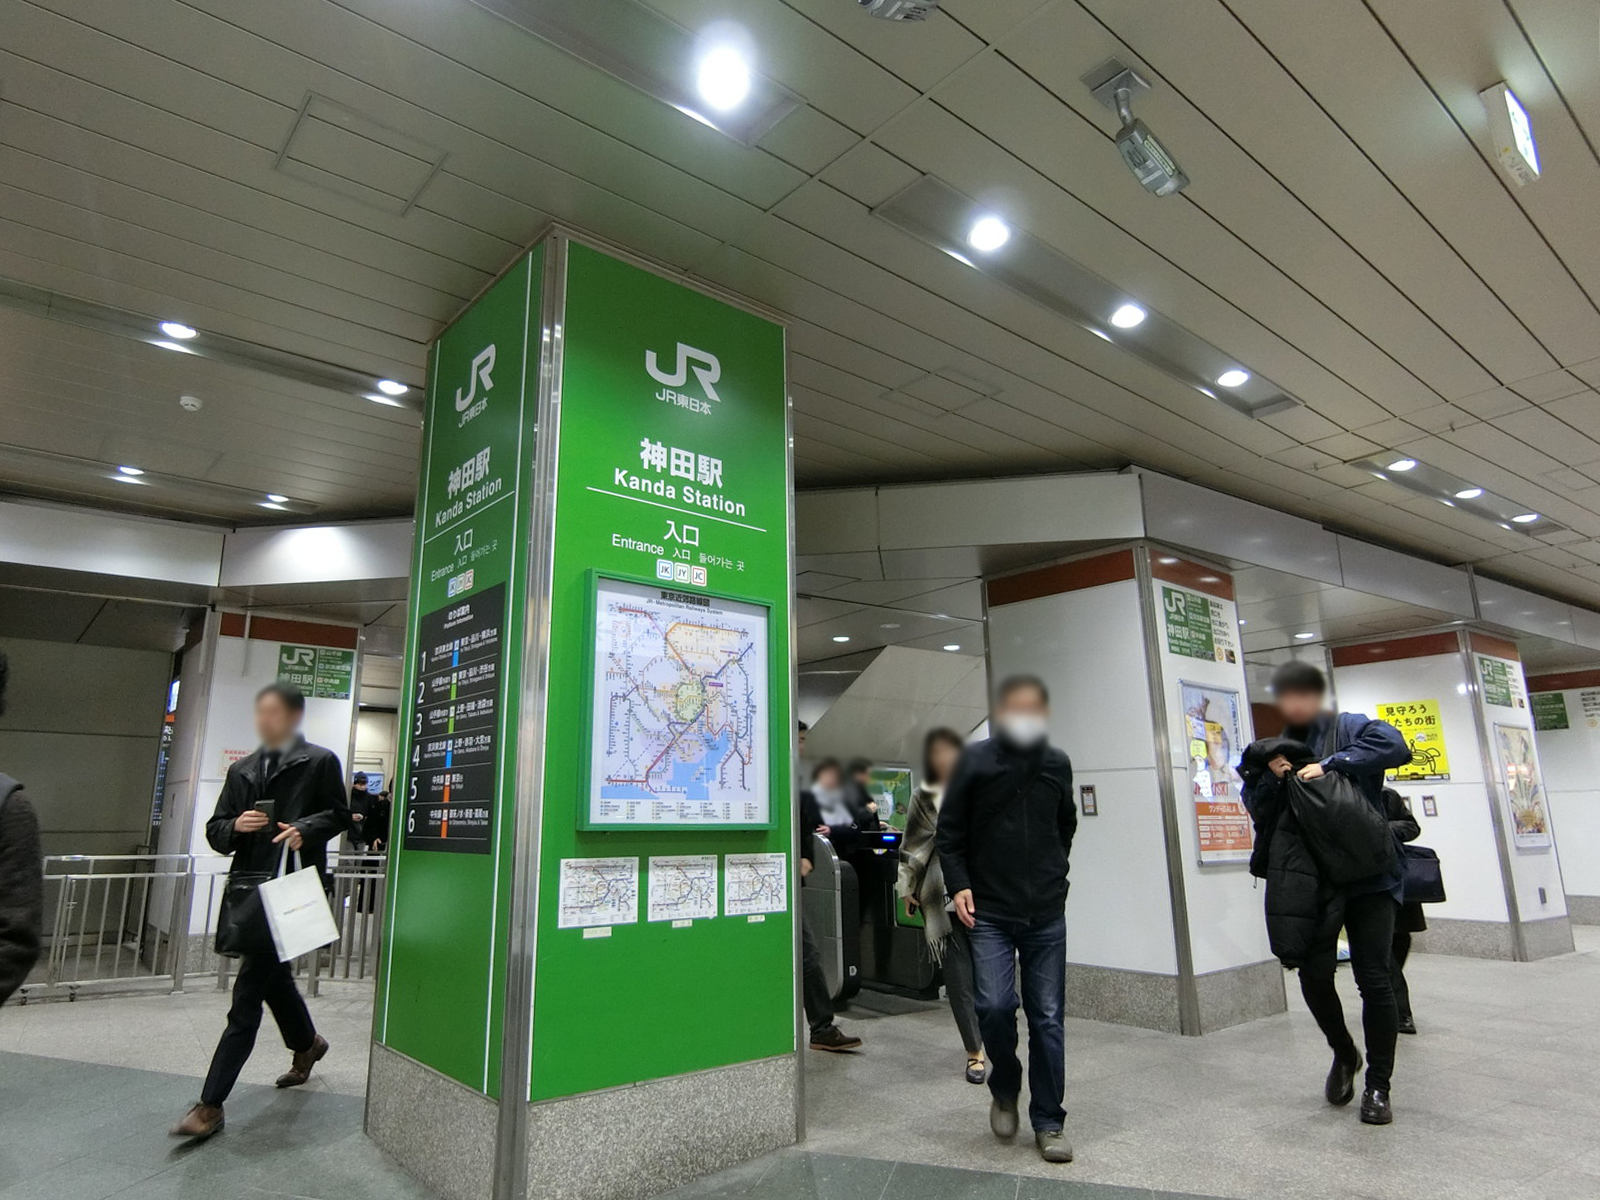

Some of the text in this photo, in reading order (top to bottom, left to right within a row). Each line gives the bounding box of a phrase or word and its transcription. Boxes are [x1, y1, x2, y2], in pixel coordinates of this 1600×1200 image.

[455, 343, 497, 412] JR
[645, 341, 722, 402] JR
[655, 388, 712, 415] JR東日本
[447, 446, 491, 500] 神田駅
[640, 437, 723, 489] 神田駅
[435, 477, 502, 528] Kanda Station
[614, 468, 746, 517] Kanda Station
[454, 528, 473, 556] 入口
[663, 520, 699, 547] 入口
[612, 534, 665, 556] Entrance
[672, 547, 691, 560] 入口
[699, 552, 734, 571] 들어가는
[431, 563, 454, 583] Entrance
[661, 565, 703, 581] JK JY JC
[1164, 591, 1187, 616] JR
[1167, 623, 1190, 640] 神田駅
[281, 648, 315, 666] JR
[421, 651, 427, 672] 1
[417, 682, 425, 704] 2
[1385, 704, 1428, 717] 見守ろう
[415, 713, 423, 736] 3
[412, 744, 420, 767] 4
[410, 777, 418, 800] 5
[408, 809, 415, 833] 6
